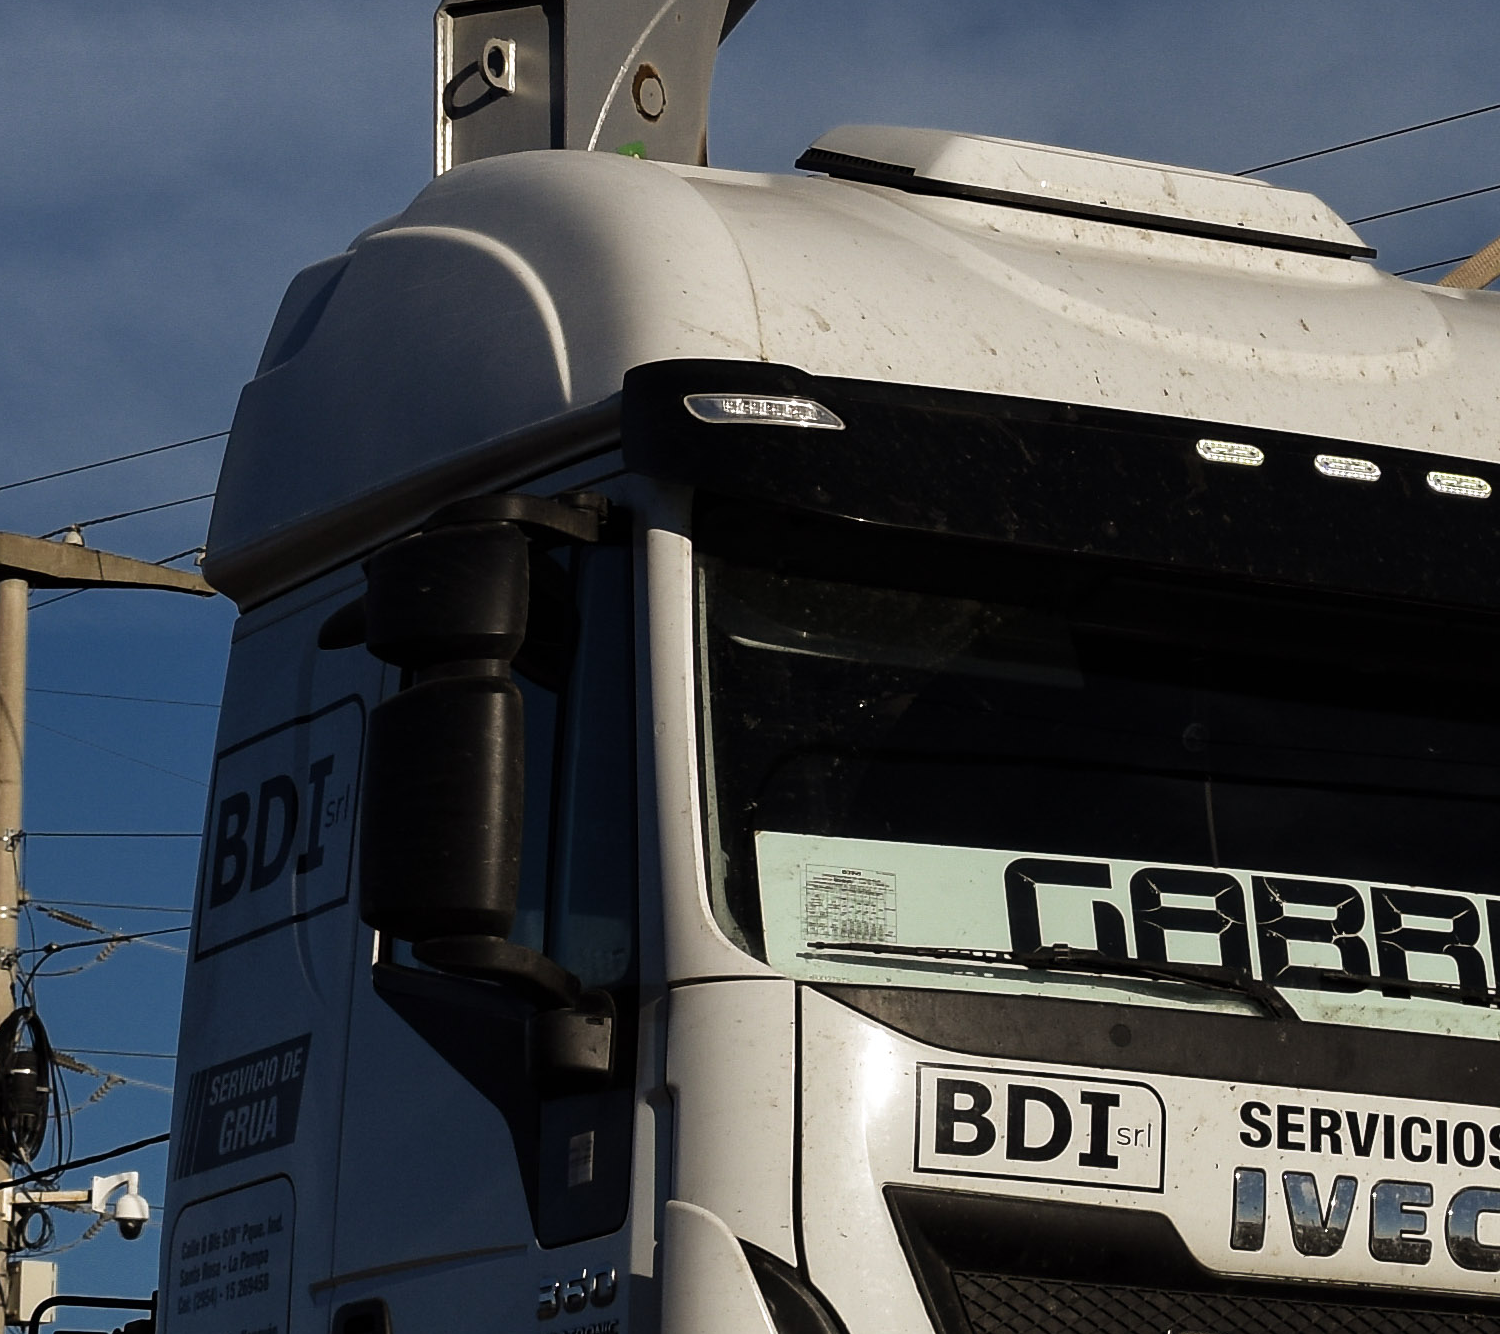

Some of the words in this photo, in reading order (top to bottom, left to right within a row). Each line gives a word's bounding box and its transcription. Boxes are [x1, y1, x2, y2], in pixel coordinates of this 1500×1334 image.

[210, 753, 335, 909] BDI
[325, 784, 351, 829] srl
[208, 1055, 279, 1107] SERVICIO
[280, 1046, 304, 1082] DE
[218, 1097, 278, 1156] GRUA
[935, 1077, 1120, 1170] BDI
[1116, 1122, 1152, 1148] srl
[228, 1254, 238, 1273] La
[240, 1249, 269, 1270] Pampa
[226, 1281, 236, 1301] 15
[536, 1263, 618, 1321] 360
